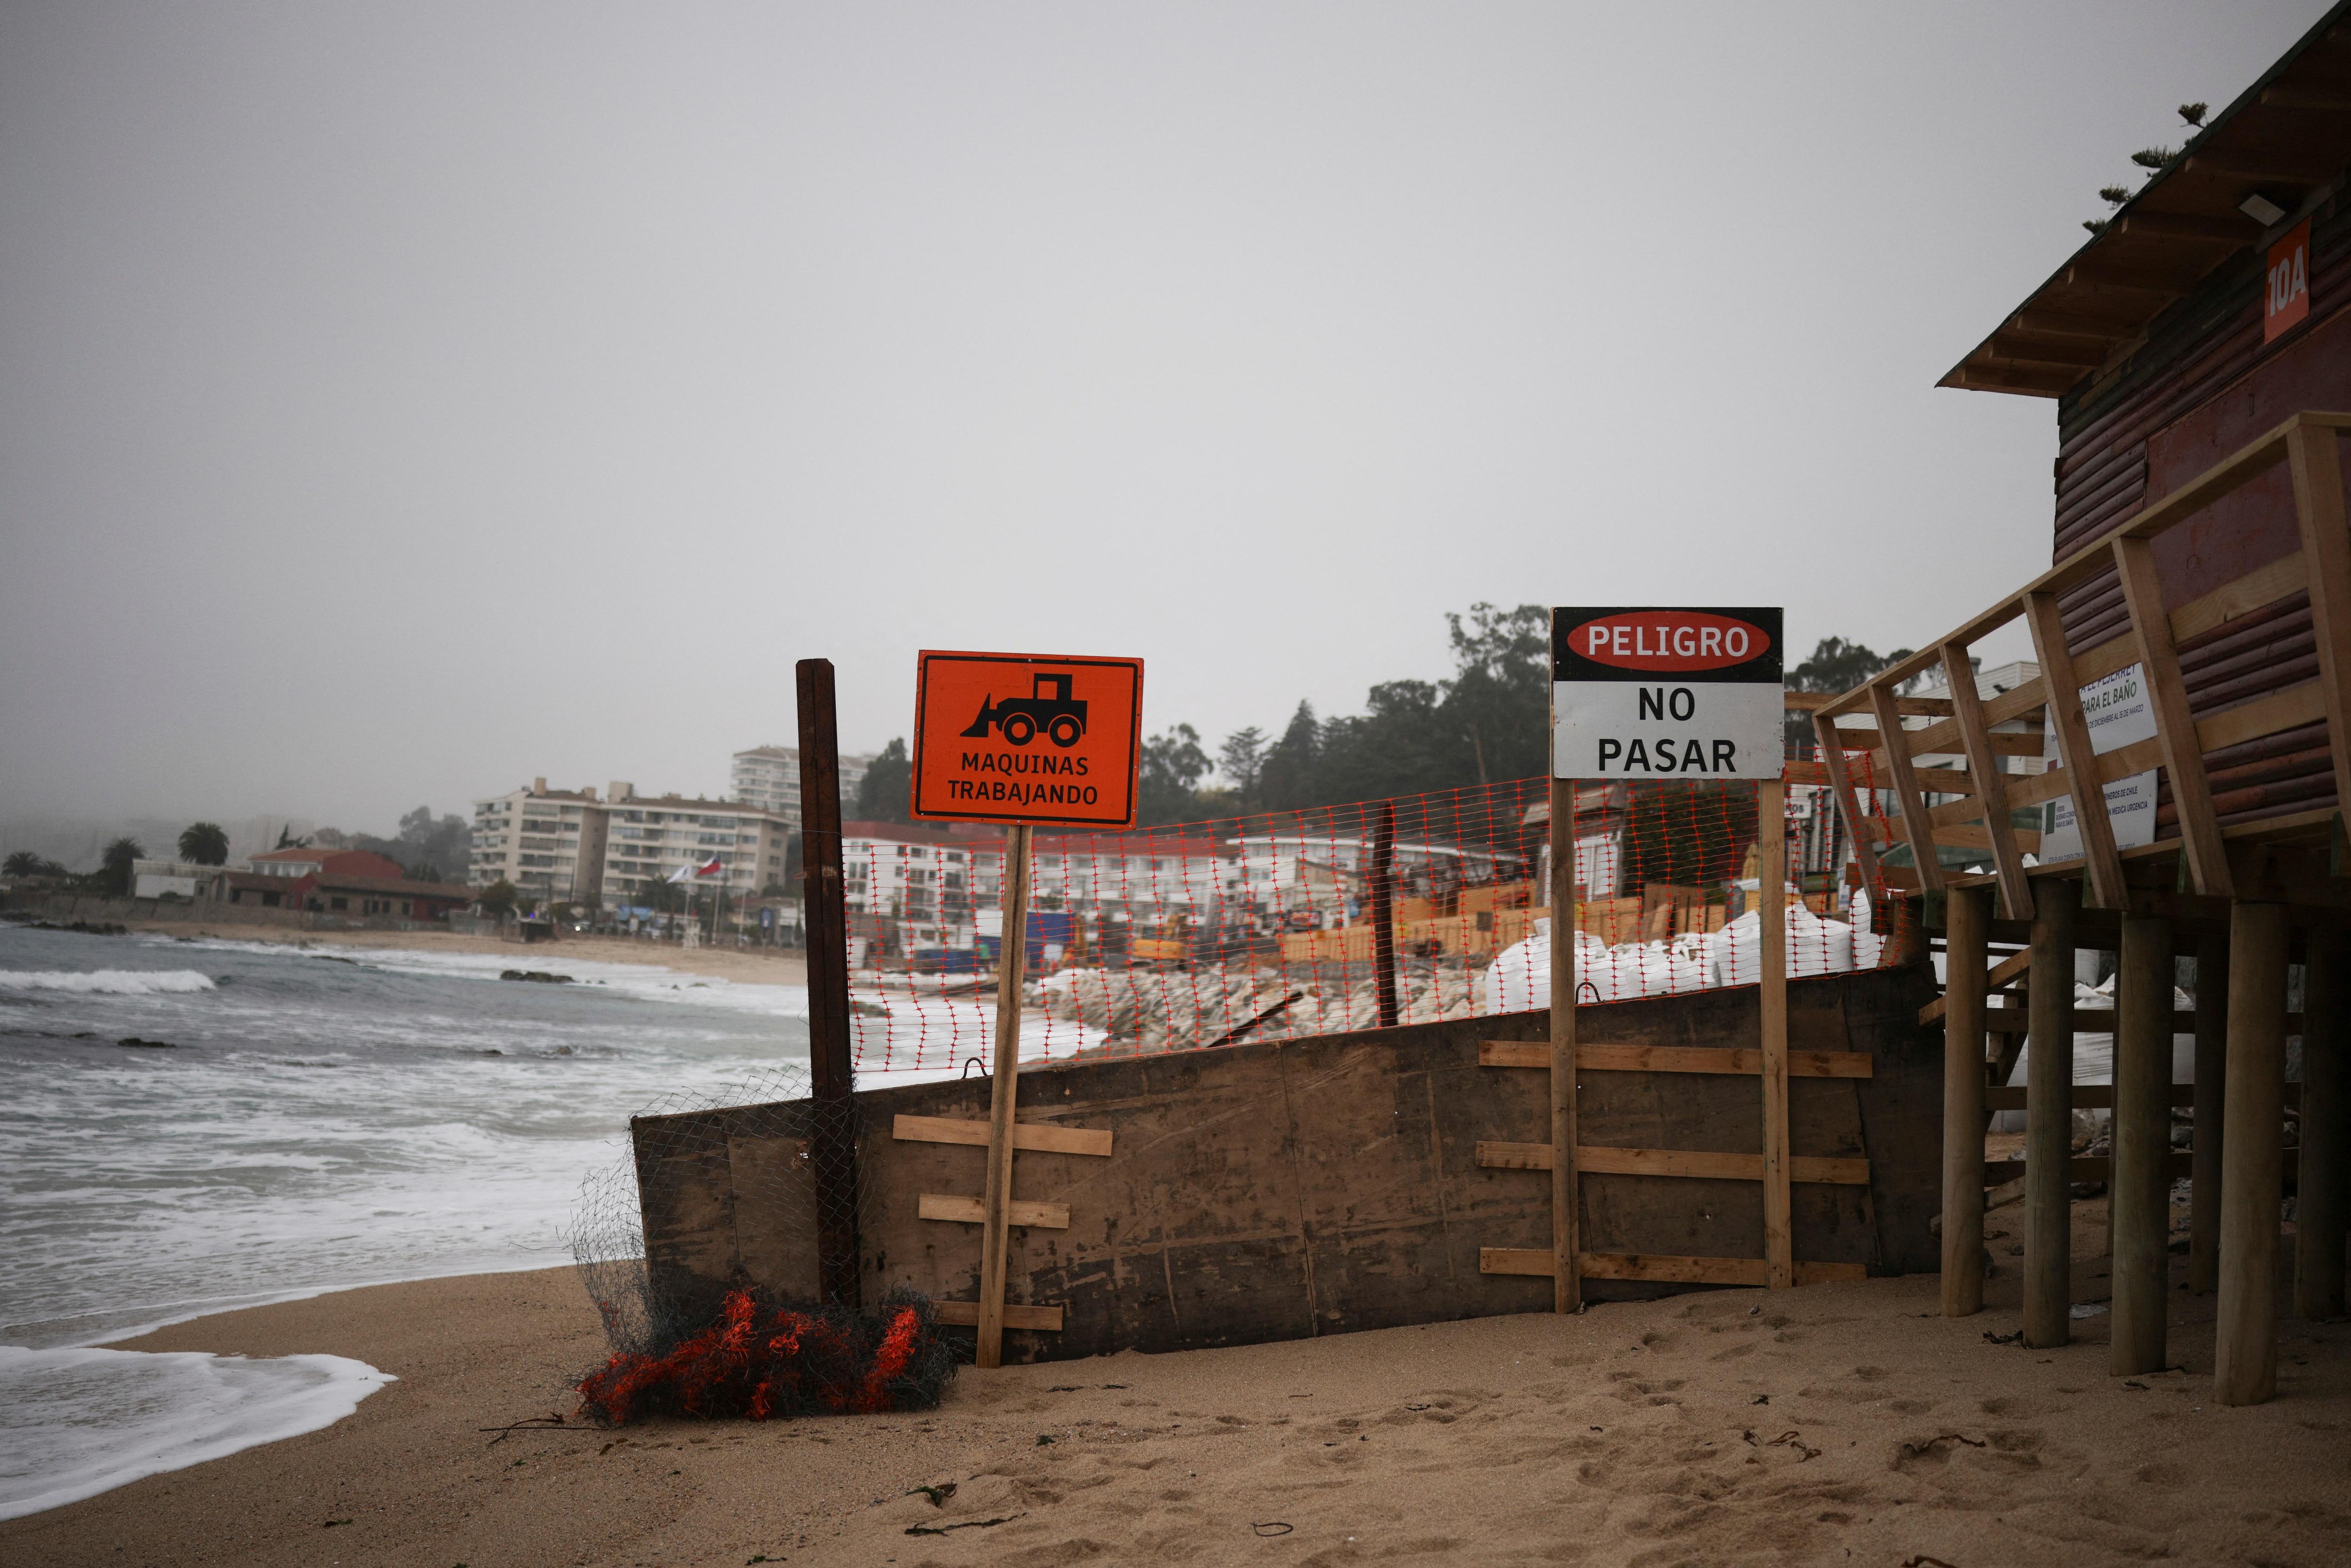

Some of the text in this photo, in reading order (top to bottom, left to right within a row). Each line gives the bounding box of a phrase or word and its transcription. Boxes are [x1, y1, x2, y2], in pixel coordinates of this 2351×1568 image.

[2268, 245, 2306, 317] 10A
[1589, 626, 1749, 657] PELIGRO
[1639, 687, 1695, 721] NO
[2082, 679, 2137, 715] PARA EL BAÑO
[2094, 714, 2114, 727] DICIEMBRE
[2119, 710, 2123, 719] 15
[2123, 708, 2129, 717] DE
[2129, 704, 2144, 715] MARZO
[962, 753, 1089, 776] MAQUINAS
[1599, 739, 1737, 772] PASAR
[948, 780, 1098, 806] TRABAJANDO
[2120, 789, 2126, 797] DE
[2126, 786, 2138, 796] CHILE
[2112, 805, 2127, 816] MEDICA
[2127, 801, 2148, 812] URGENCIA
